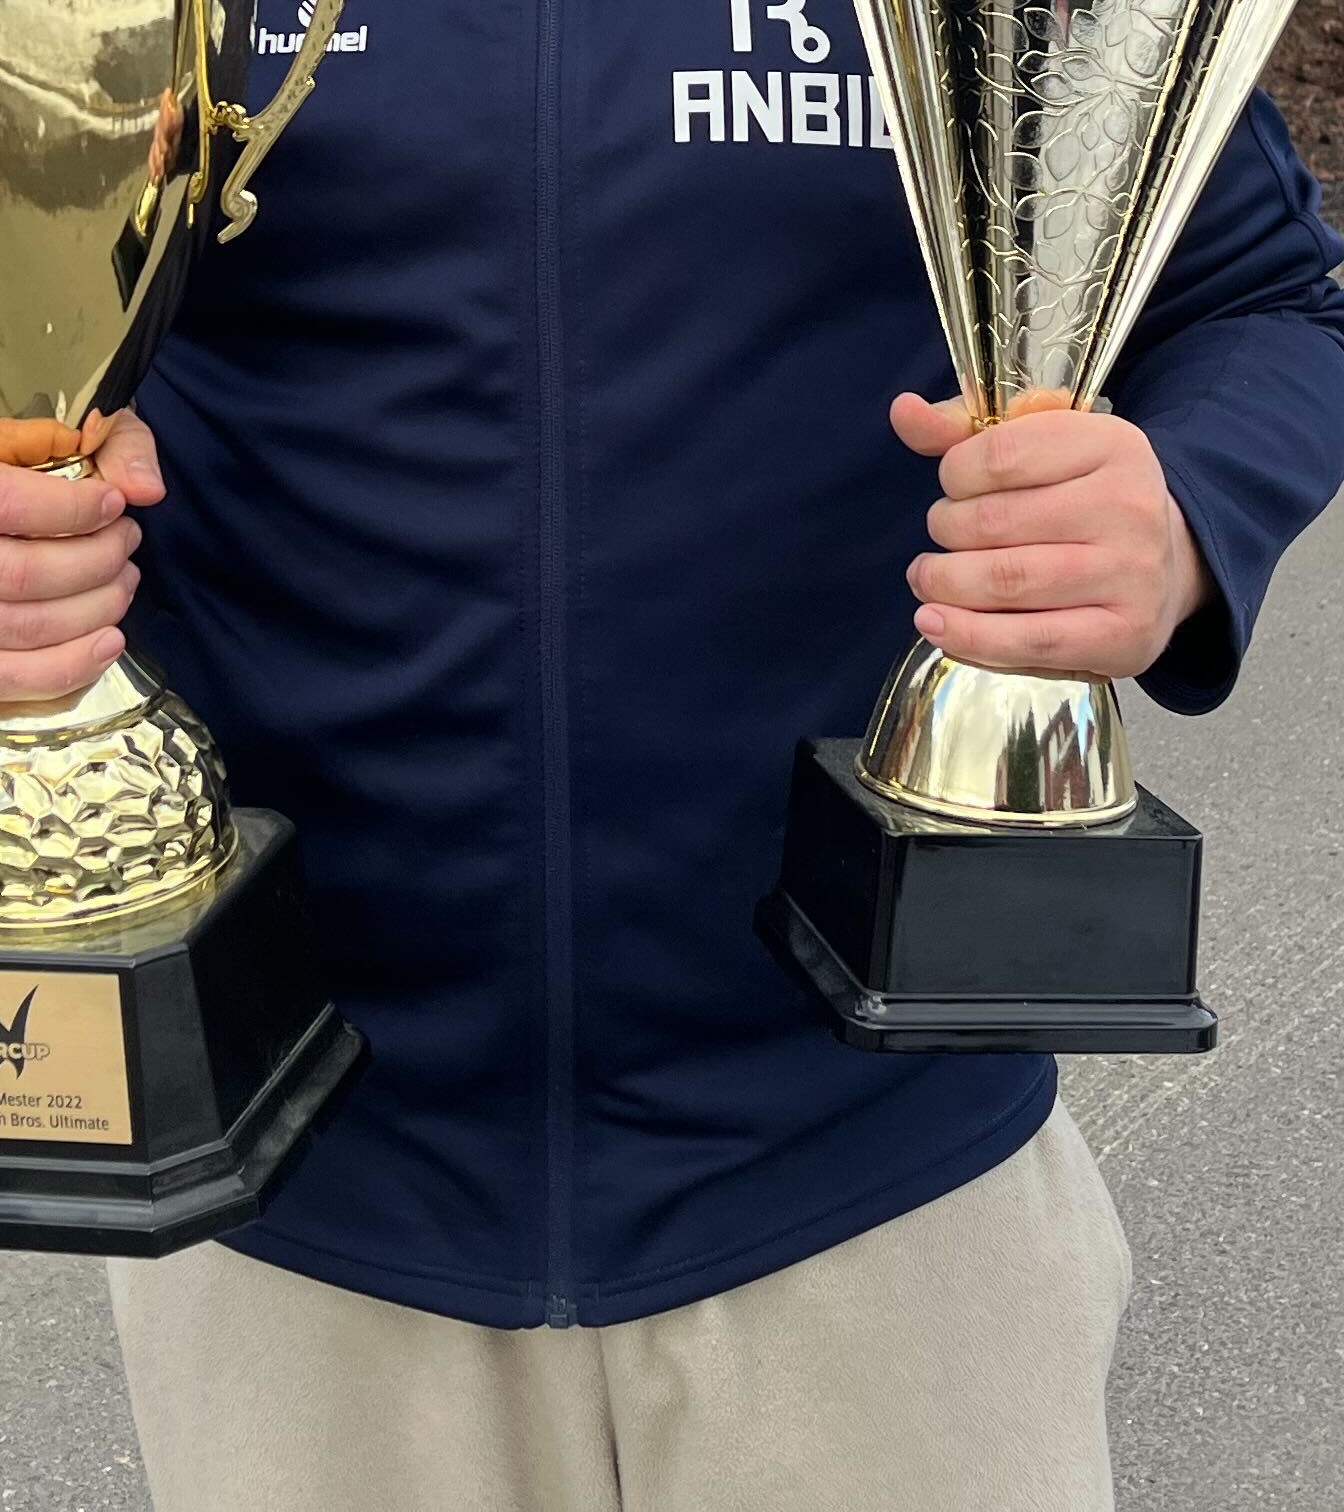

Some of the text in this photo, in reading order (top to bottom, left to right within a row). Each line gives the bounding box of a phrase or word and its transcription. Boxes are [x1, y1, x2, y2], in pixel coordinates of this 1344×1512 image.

[47, 1094, 83, 1110] 2022
[10, 1112, 46, 1129] Bros.
[49, 1114, 110, 1131] Ultimate
